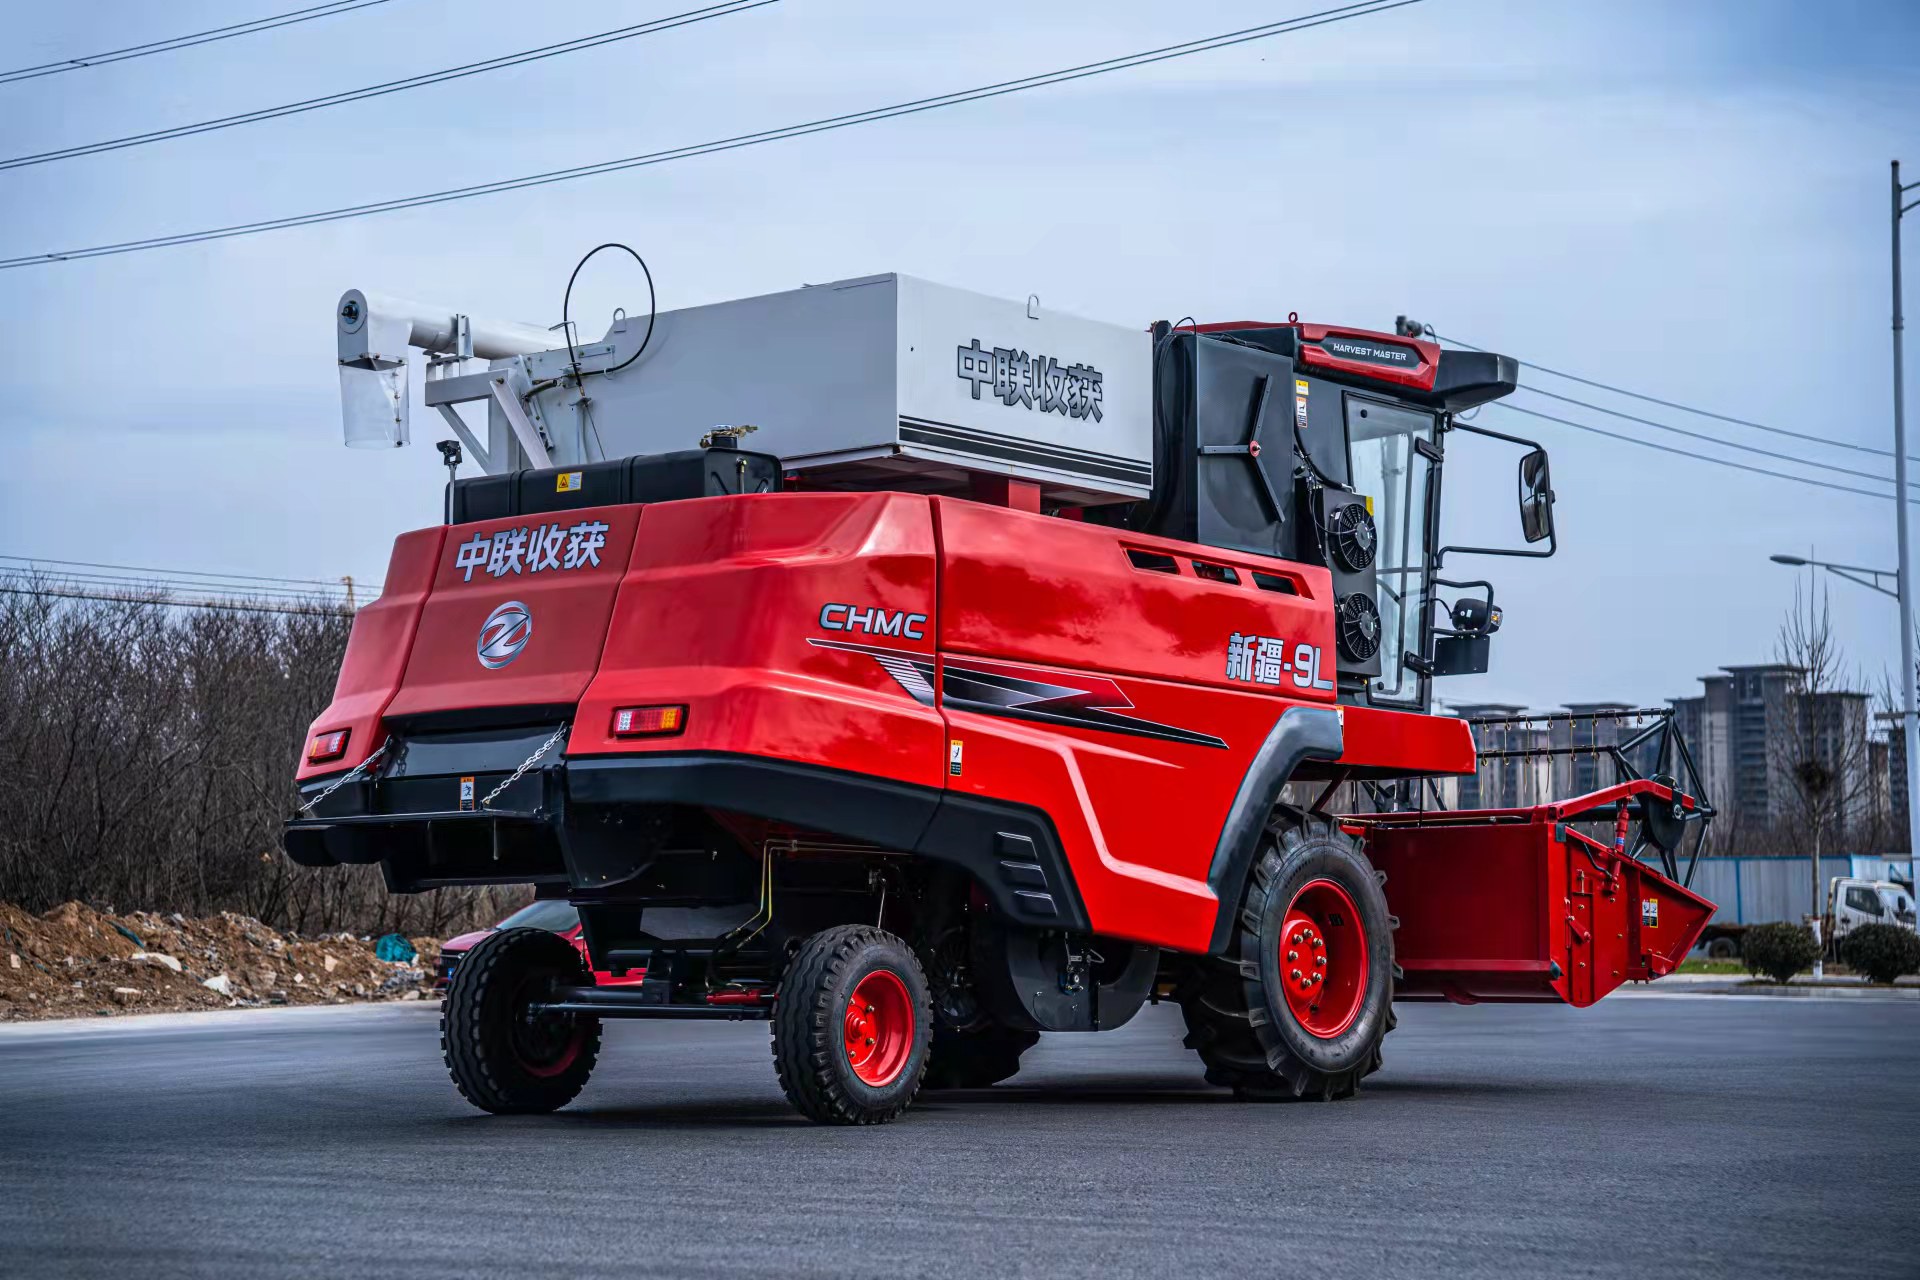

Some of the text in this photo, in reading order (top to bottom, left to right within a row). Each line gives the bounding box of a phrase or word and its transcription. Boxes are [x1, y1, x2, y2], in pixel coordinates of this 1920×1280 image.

[1333, 343, 1407, 361] HARVEST MASTER
[958, 338, 1103, 423] 中联收获
[455, 520, 610, 584] 中联收获
[819, 603, 928, 640] CHMC
